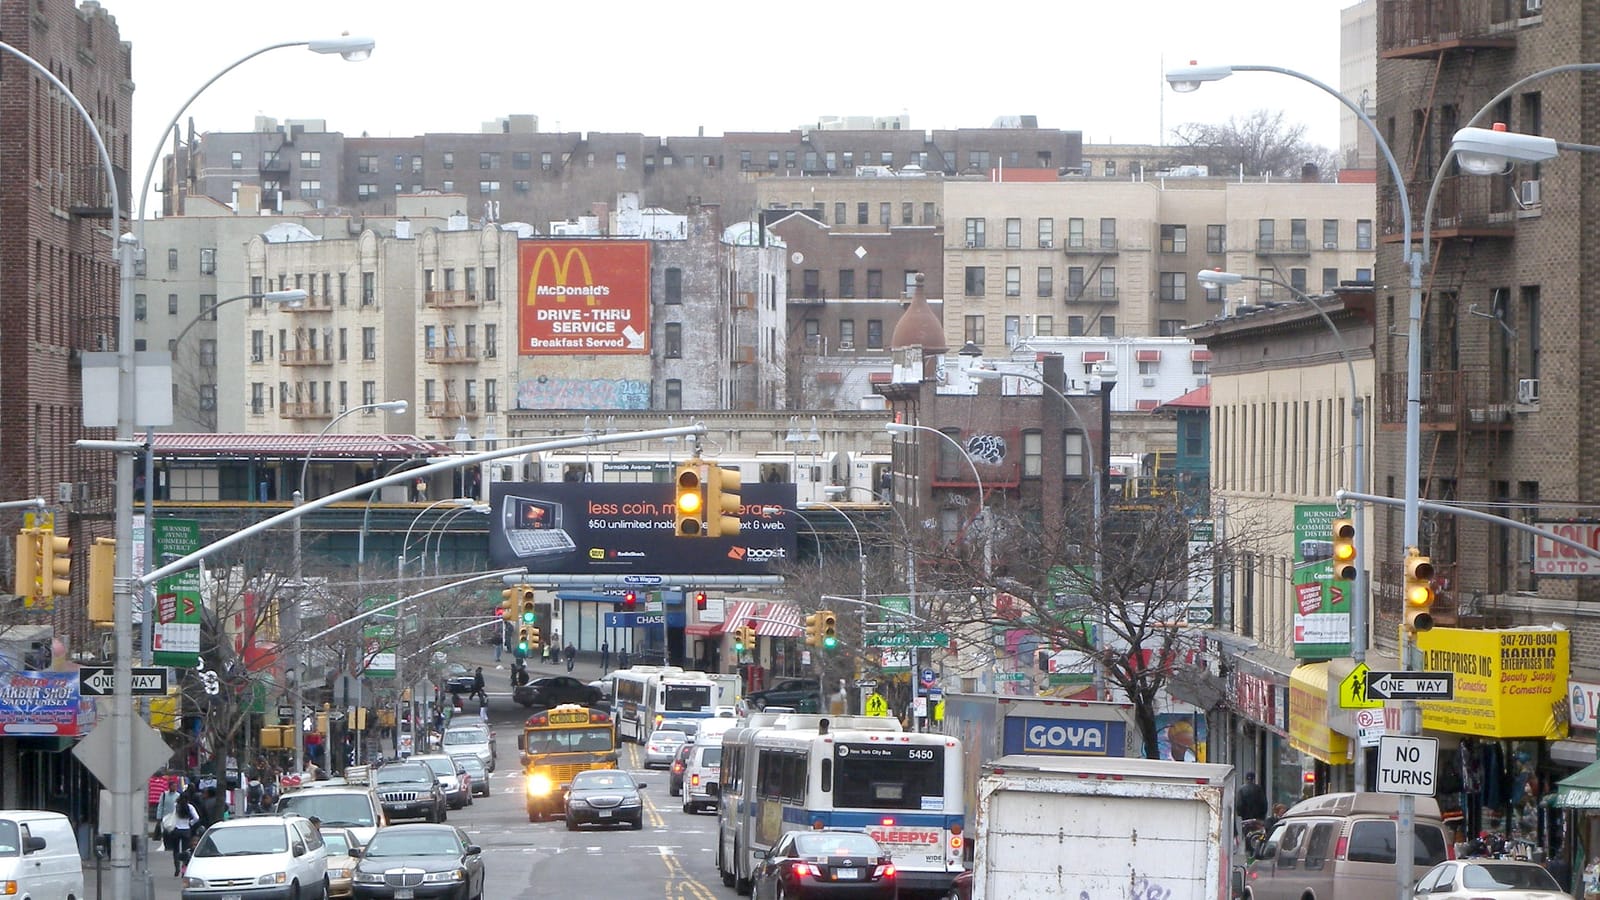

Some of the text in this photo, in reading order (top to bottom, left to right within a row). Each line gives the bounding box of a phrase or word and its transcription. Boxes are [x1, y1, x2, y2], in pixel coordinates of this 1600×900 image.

[537, 285, 610, 296] McDonald's
[537, 309, 581, 320] DRIVE
[592, 309, 631, 320] THRU
[553, 321, 616, 333] SERVICE
[531, 337, 624, 347] Breakfast Served
[588, 500, 618, 515] less
[622, 500, 658, 516] coin,
[588, 519, 606, 530] $50
[608, 519, 652, 530] unlimited
[762, 520, 786, 530] web.
[747, 547, 786, 558] boost
[1536, 561, 1589, 573] LOTTO
[637, 615, 664, 624] CHASE
[1431, 649, 1477, 675] ENTERPRISES
[1479, 655, 1492, 678] INC
[1501, 657, 1555, 670] ENTERPRISES INC
[93, 676, 156, 688] ONE WAY
[1501, 671, 1556, 683] Beauty Supply
[1380, 680, 1442, 692] ONE WAY
[0, 686, 75, 699] ARBER SHOP
[1029, 725, 1102, 748] GOYA
[909, 749, 934, 760] 5450
[1396, 746, 1420, 763] NO
[1381, 768, 1432, 786] TURNS
